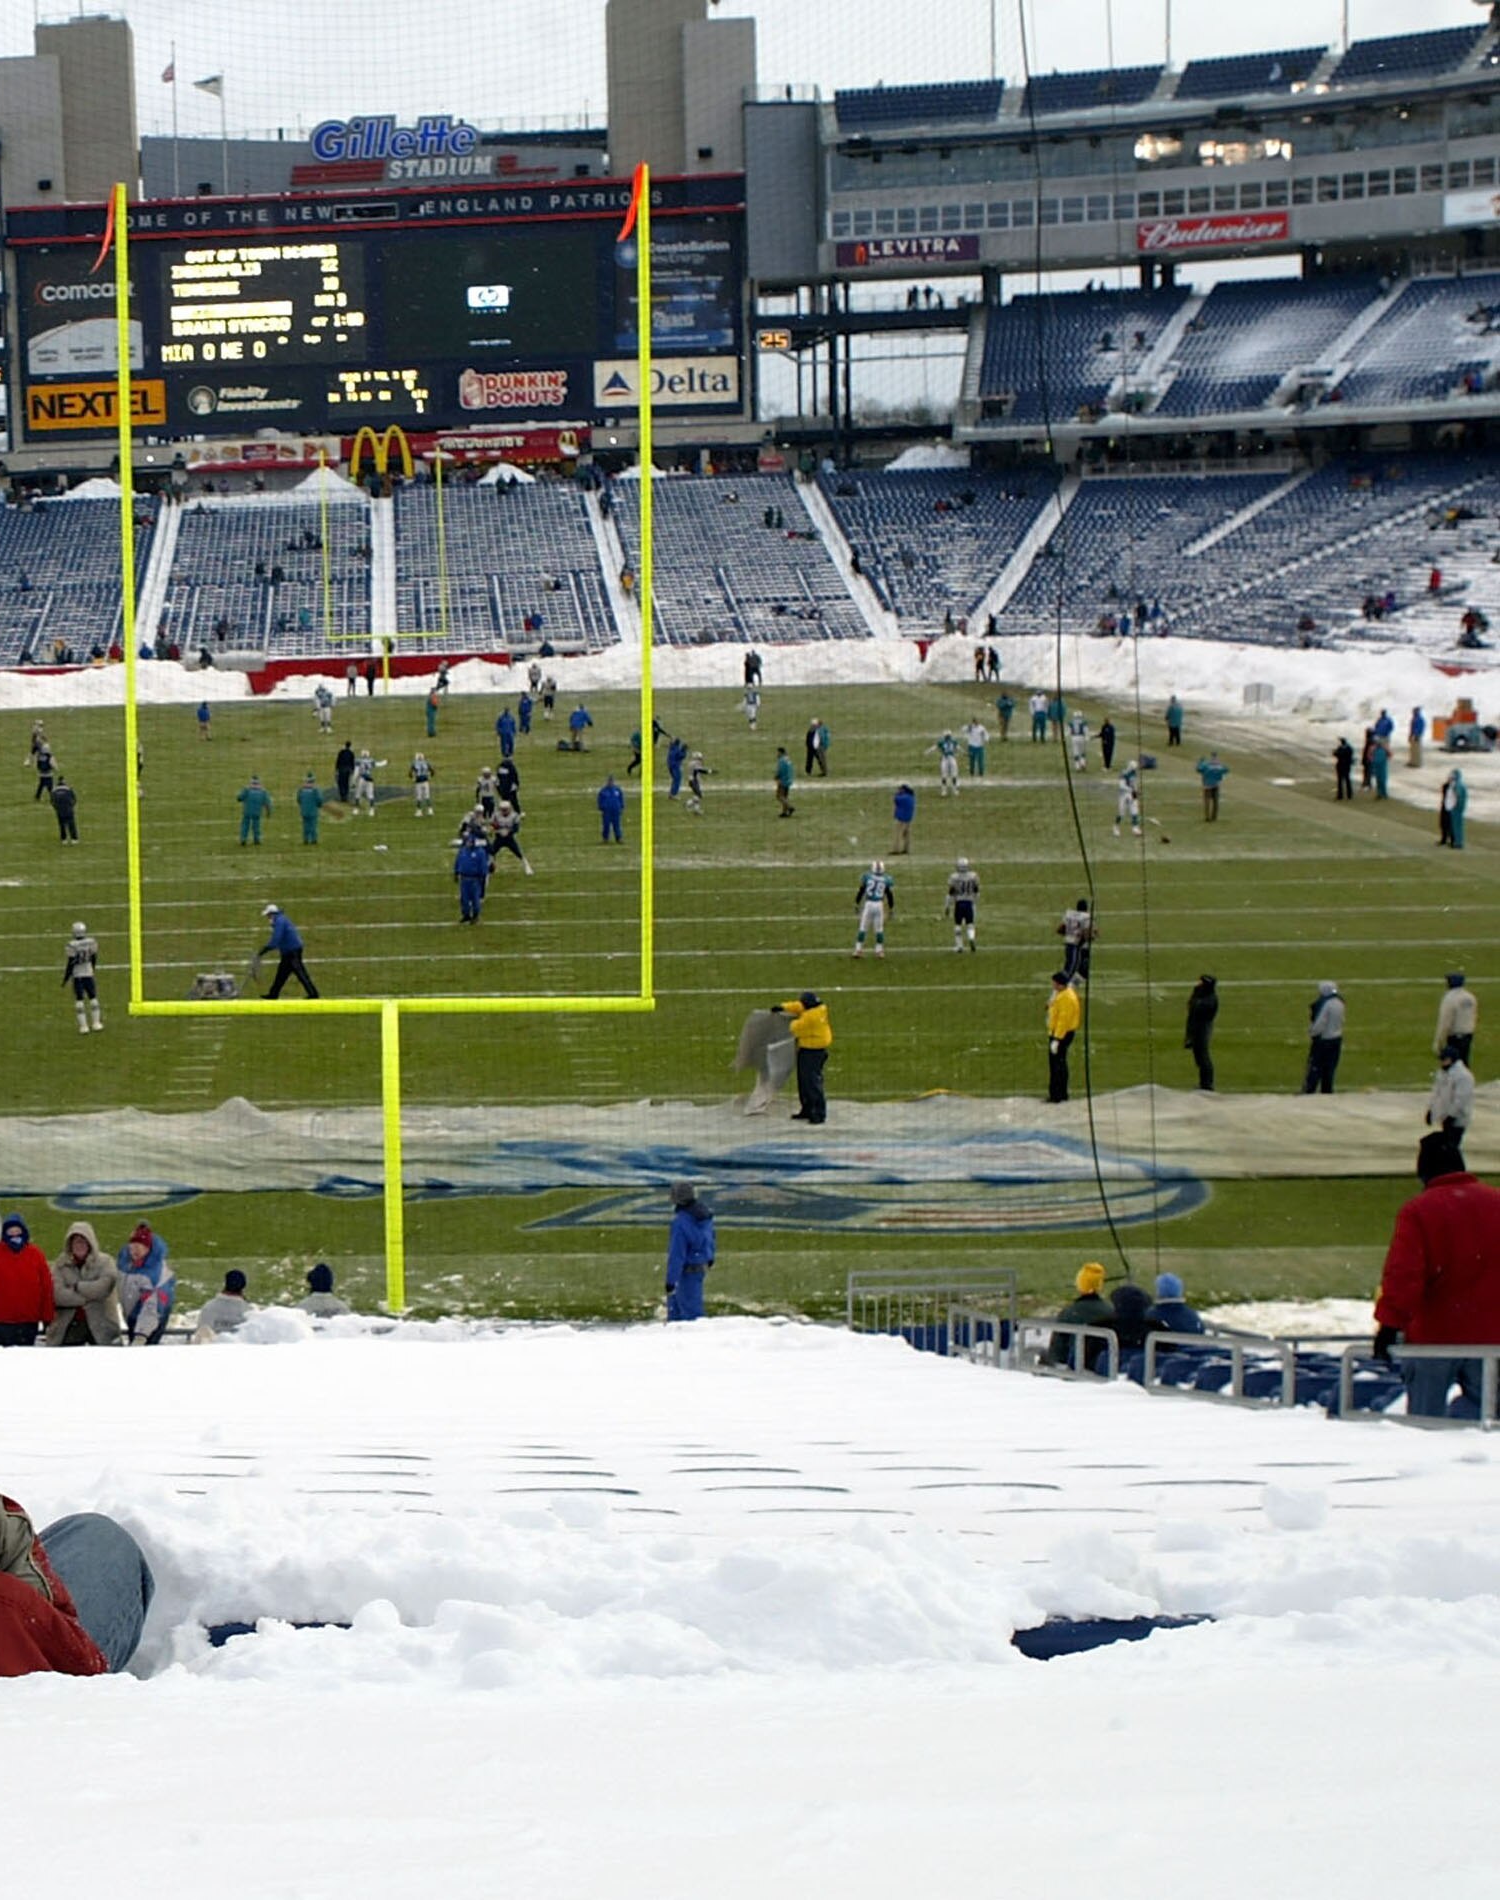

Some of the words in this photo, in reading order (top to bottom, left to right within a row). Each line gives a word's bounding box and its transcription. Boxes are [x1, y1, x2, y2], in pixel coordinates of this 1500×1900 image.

[311, 115, 479, 162] Gillette
[389, 156, 493, 179] STADIUM
[125, 213, 168, 228] OME
[184, 211, 212, 225] OF
[226, 208, 269, 223] THE
[285, 205, 333, 220] NEW
[424, 195, 533, 215] ENGLAND
[550, 190, 664, 209] PATRIOS
[1140, 216, 1285, 249] Budweiser
[869, 237, 960, 256] LEVITRA
[41, 281, 137, 302] comcat
[760, 332, 789, 349] 25
[161, 343, 195, 363] MIA
[202, 342, 216, 361] 0
[220, 341, 244, 360] NE
[252, 340, 266, 359] 0
[485, 372, 567, 389] DUNKIN'
[218, 385, 270, 400] Fidelity
[485, 389, 564, 405] DONUTS
[31, 389, 162, 421] NEXTEL
[215, 398, 303, 412] Investments
